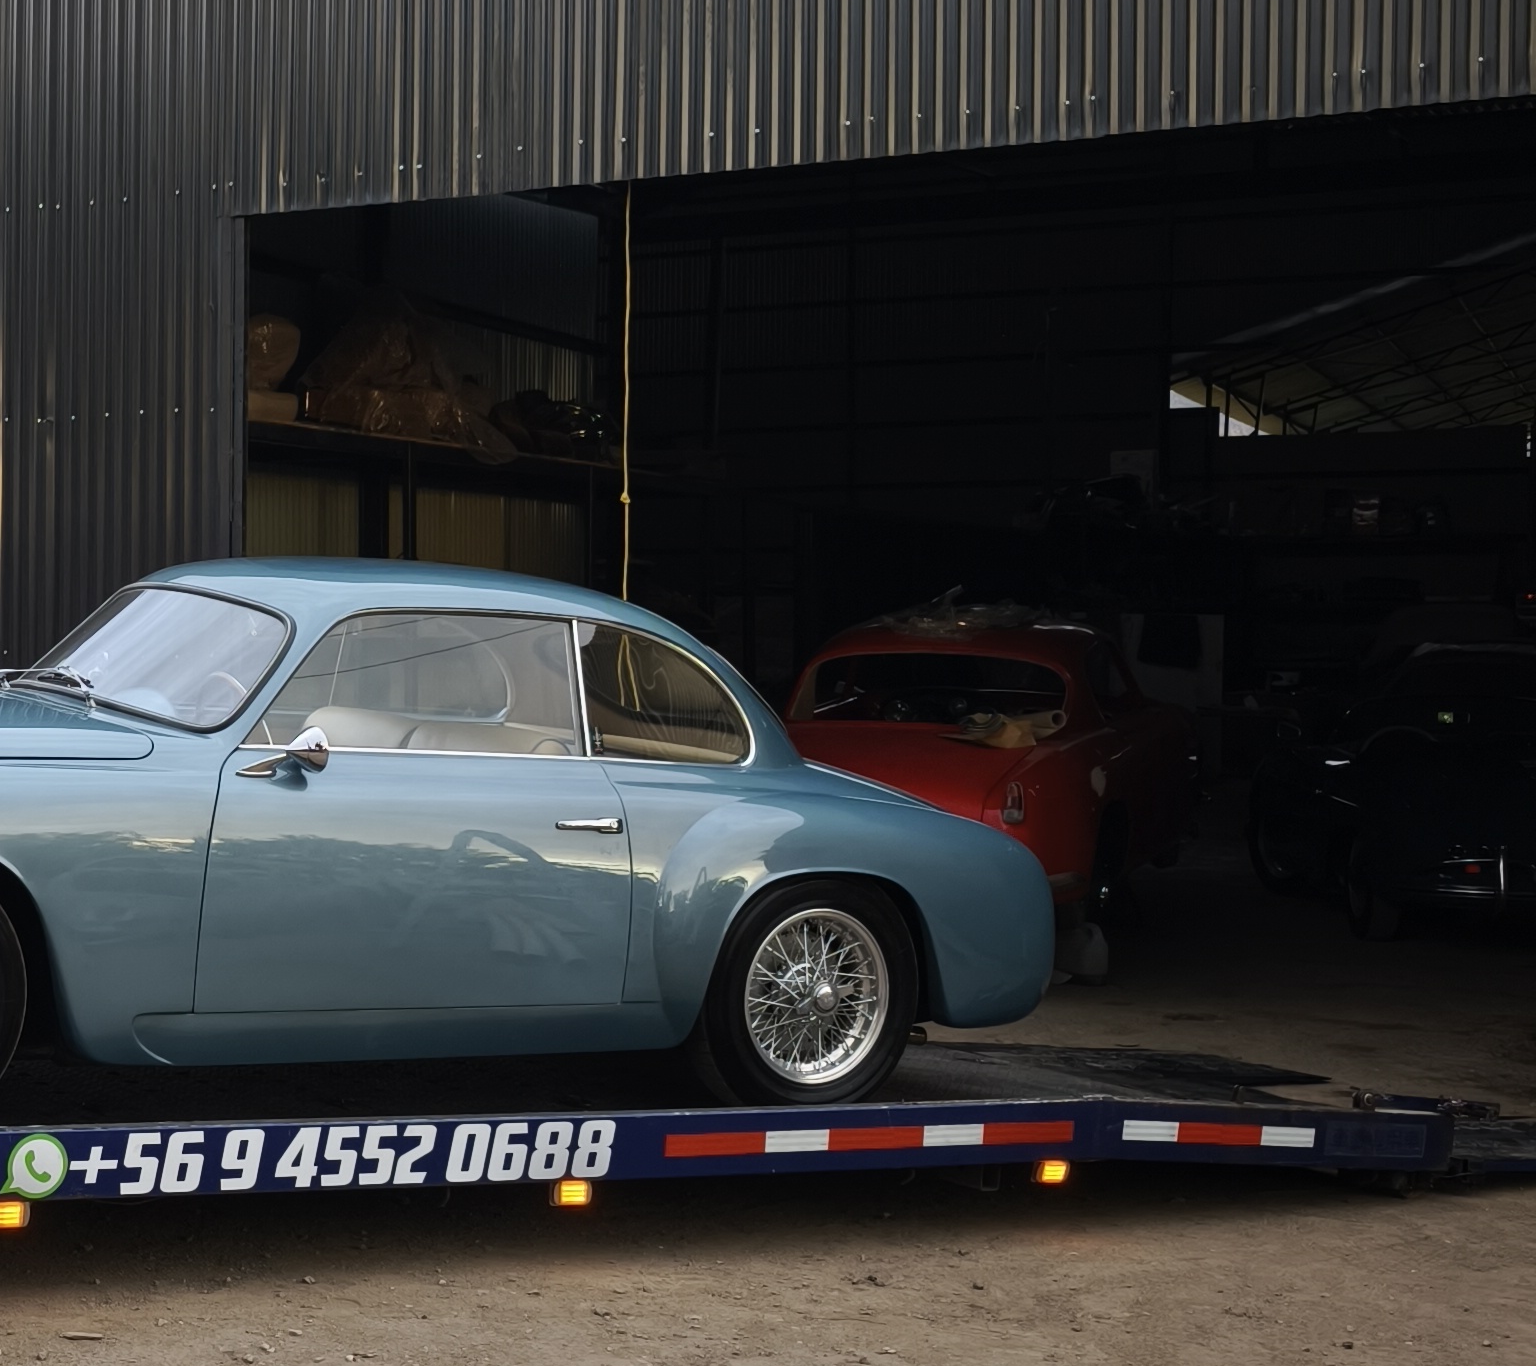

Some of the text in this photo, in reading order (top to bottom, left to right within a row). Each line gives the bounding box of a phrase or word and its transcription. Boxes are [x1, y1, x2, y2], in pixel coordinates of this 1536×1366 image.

[68, 1119, 617, 1196] +56 9 4552 0688
